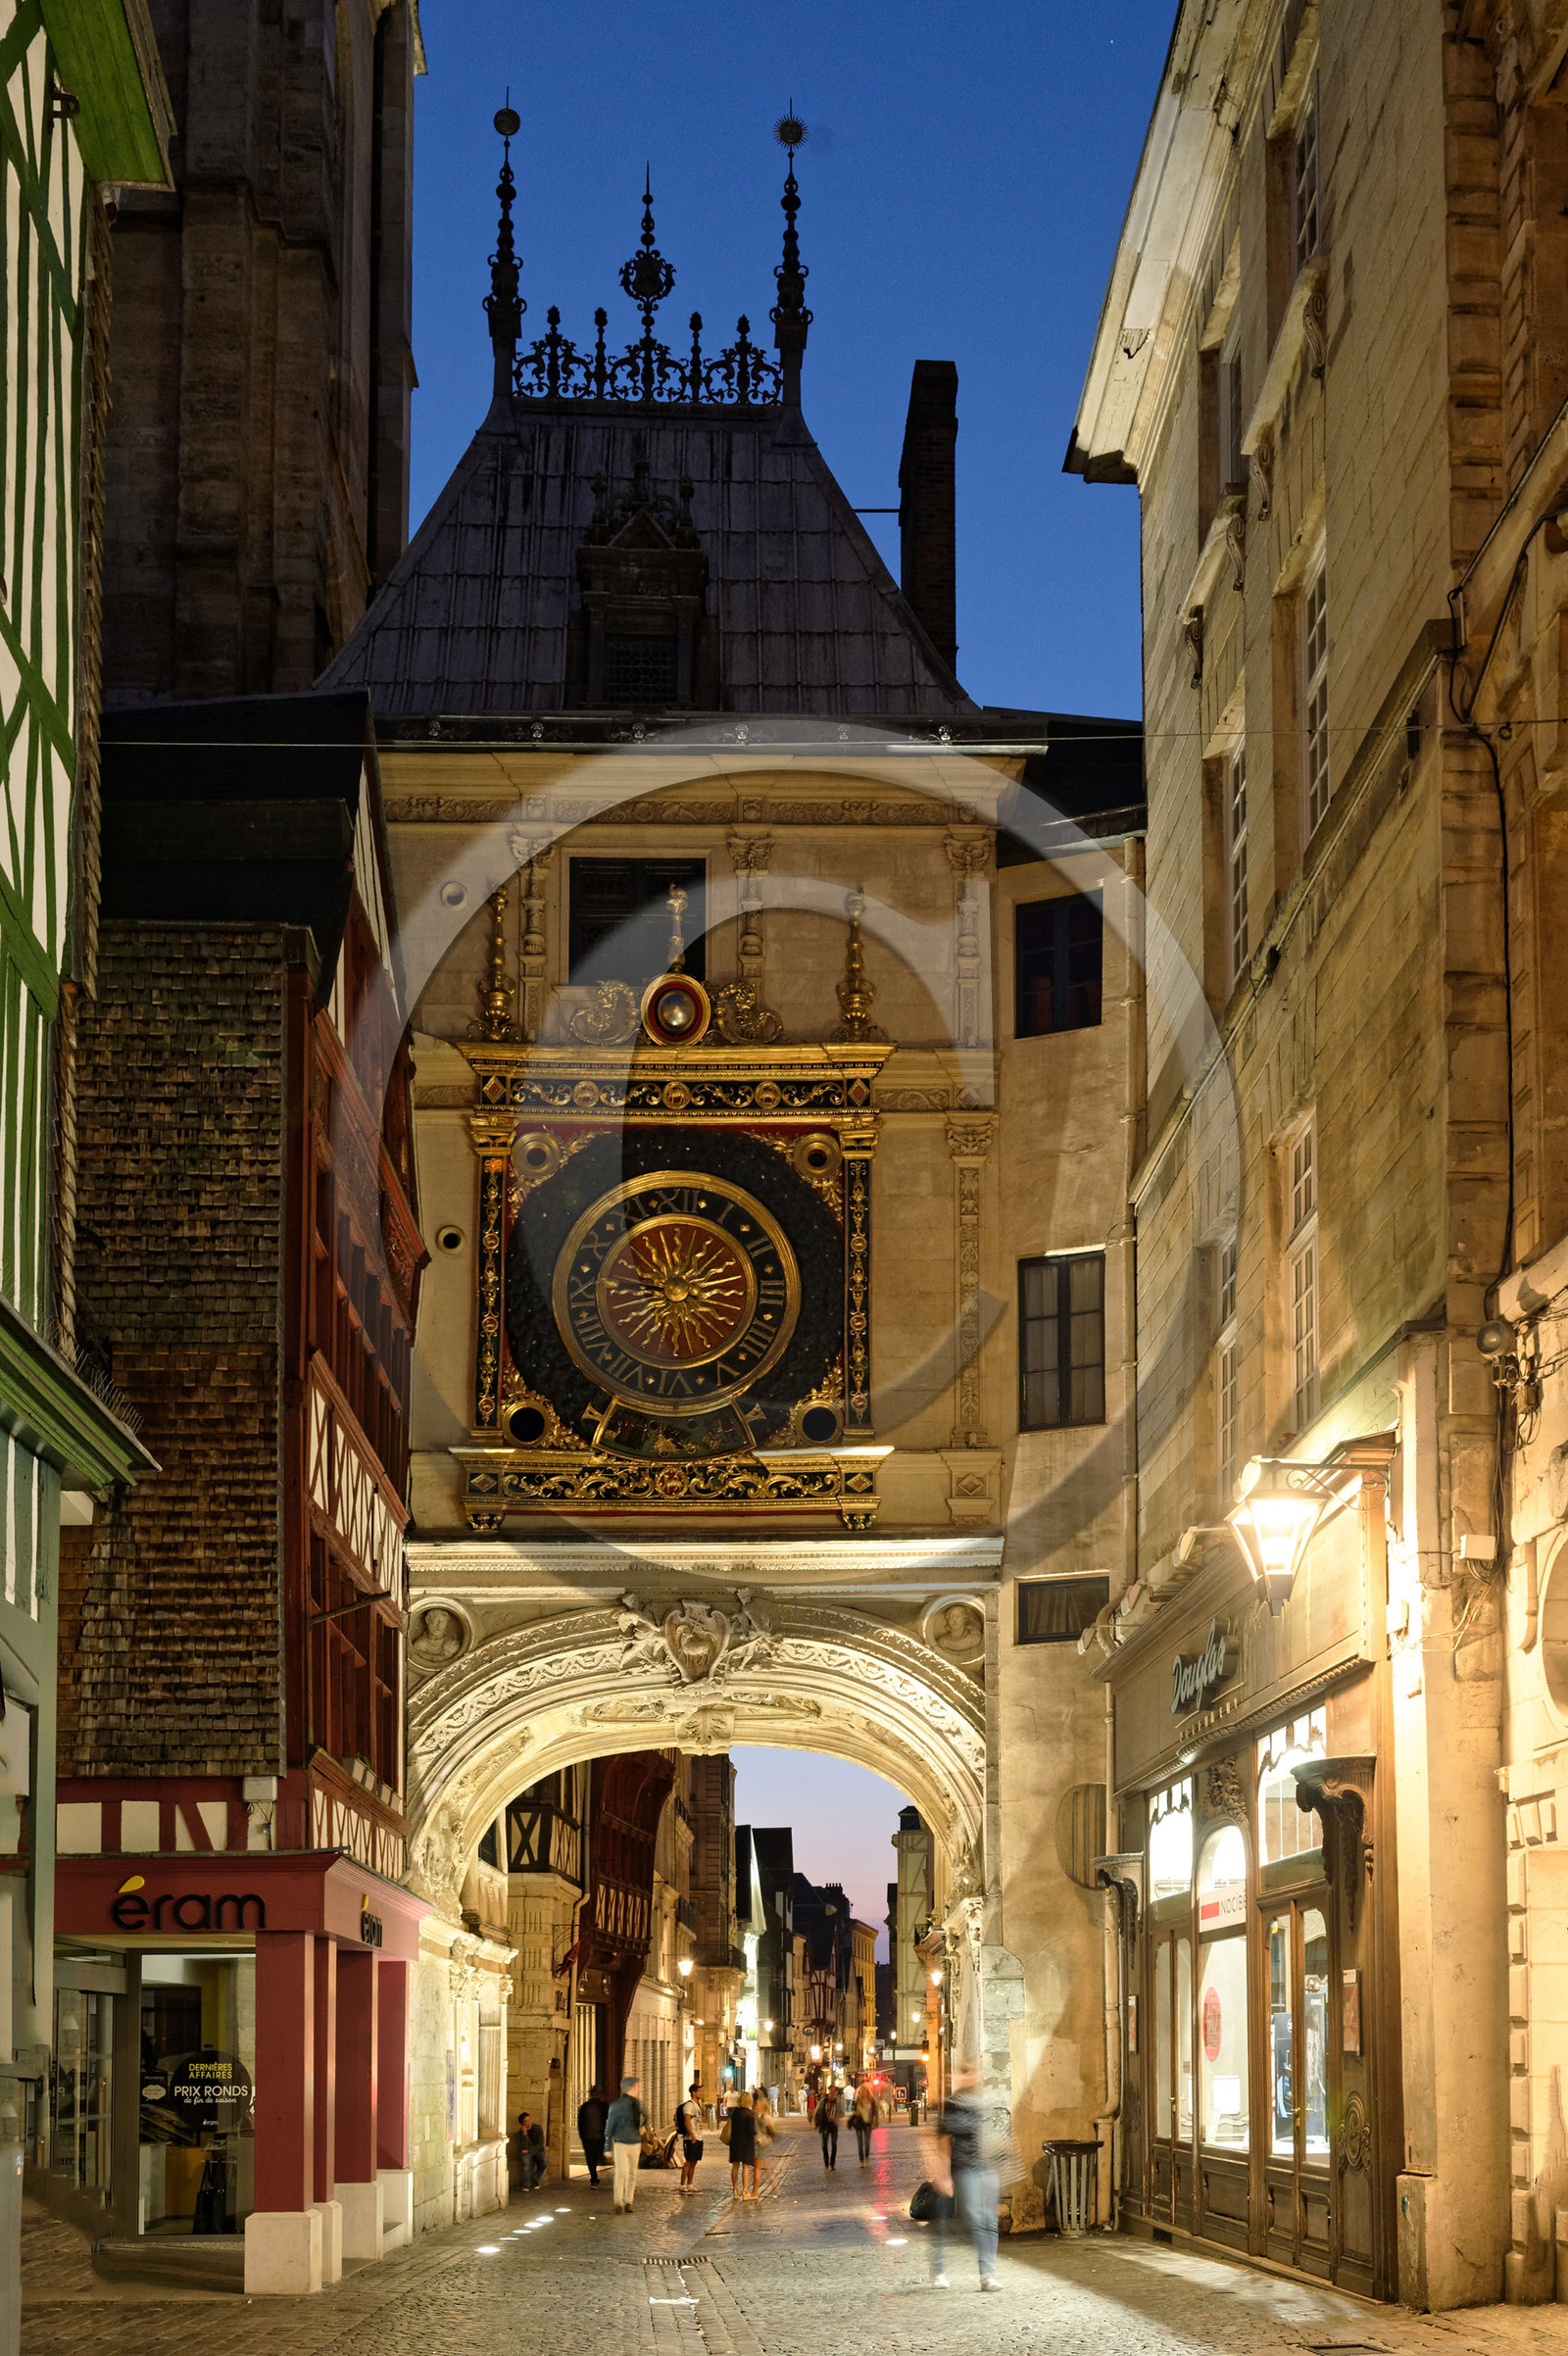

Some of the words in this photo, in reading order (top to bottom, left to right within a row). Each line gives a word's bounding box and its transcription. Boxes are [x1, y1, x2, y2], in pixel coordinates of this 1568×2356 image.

[609, 1195, 650, 1233] XI
[655, 1189, 701, 1214] XII
[717, 1202, 735, 1225] I
[580, 1229, 612, 1261] X
[746, 1236, 775, 1259] II
[569, 1275, 597, 1309] IX
[760, 1279, 785, 1306] III
[573, 1314, 612, 1365] VIII
[606, 1351, 645, 1391] VII
[657, 1369, 694, 1396] VI
[716, 1360, 741, 1386] V
[1170, 1616, 1227, 1714] Douglas
[112, 1875, 267, 1931] éram
[361, 1893, 383, 1947] éram
[188, 2062, 232, 2072] DERNIÈRES
[174, 2086, 201, 2096] PRIX
[204, 2086, 249, 2096] RONDS
[193, 2096, 204, 2105] fin
